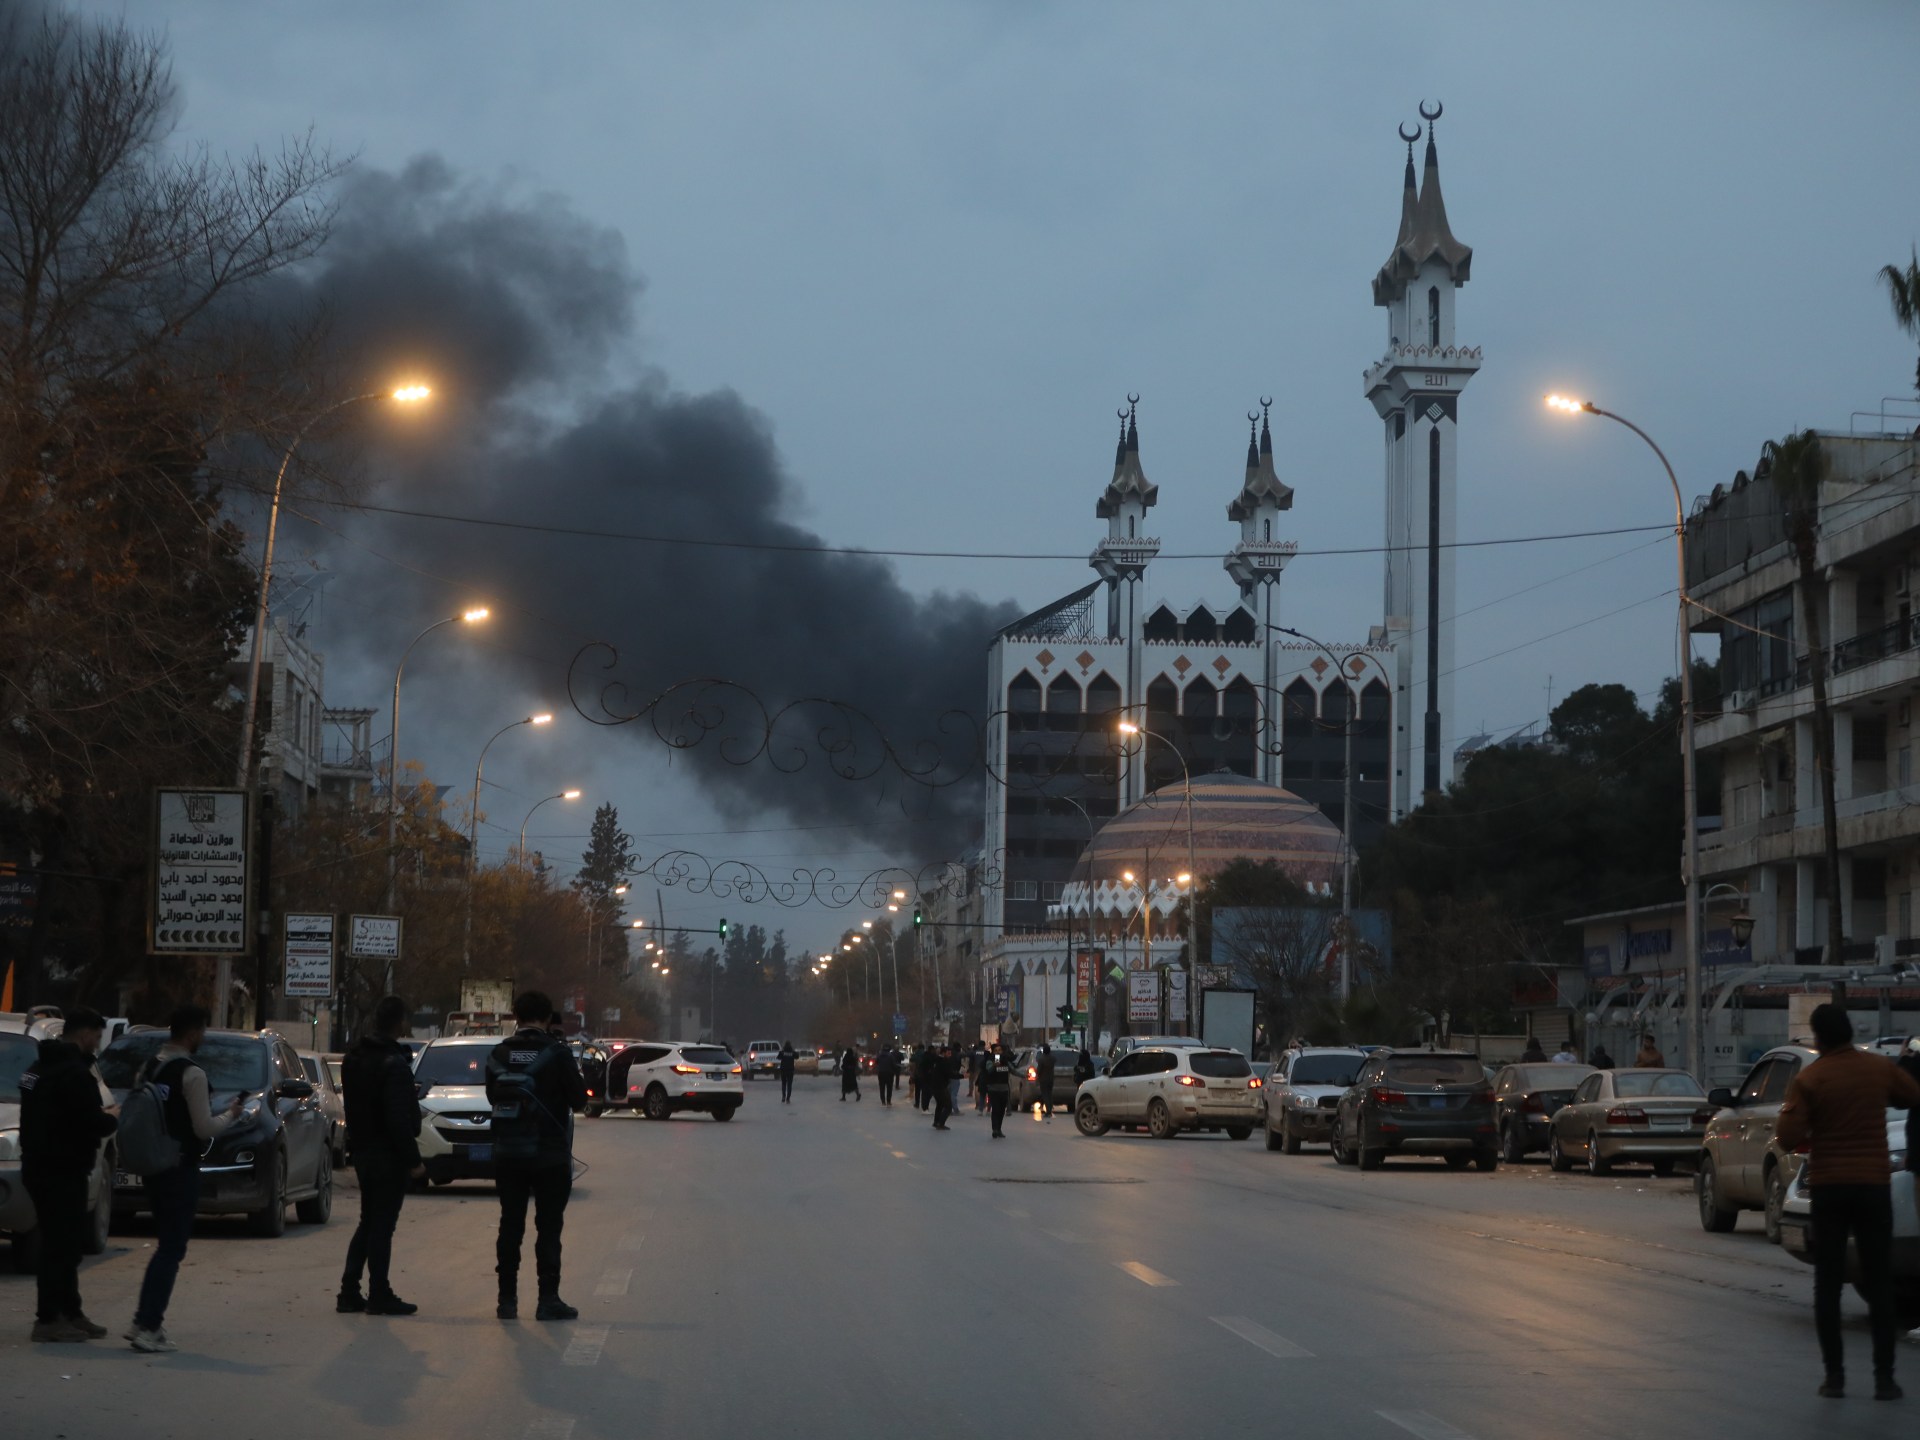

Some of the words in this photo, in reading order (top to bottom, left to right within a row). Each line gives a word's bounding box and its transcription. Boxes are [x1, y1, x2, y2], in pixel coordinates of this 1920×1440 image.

[169, 833, 204, 845] للمحاماة
[206, 834, 234, 846] موازين
[191, 850, 243, 862] والاستشارات
[160, 872, 180, 888] بابي
[184, 869, 207, 884] أحمد
[212, 874, 244, 886] محمود
[161, 890, 186, 903] السيد
[189, 892, 217, 908] صبحي
[220, 892, 243, 904] محمد
[195, 909, 224, 923] الرحمن
[226, 912, 243, 924] عبد
[360, 920, 392, 934] SILVA
[300, 972, 315, 980] كمال
[511, 1053, 537, 1062] PRESS
[117, 1174, 129, 1185] 06
